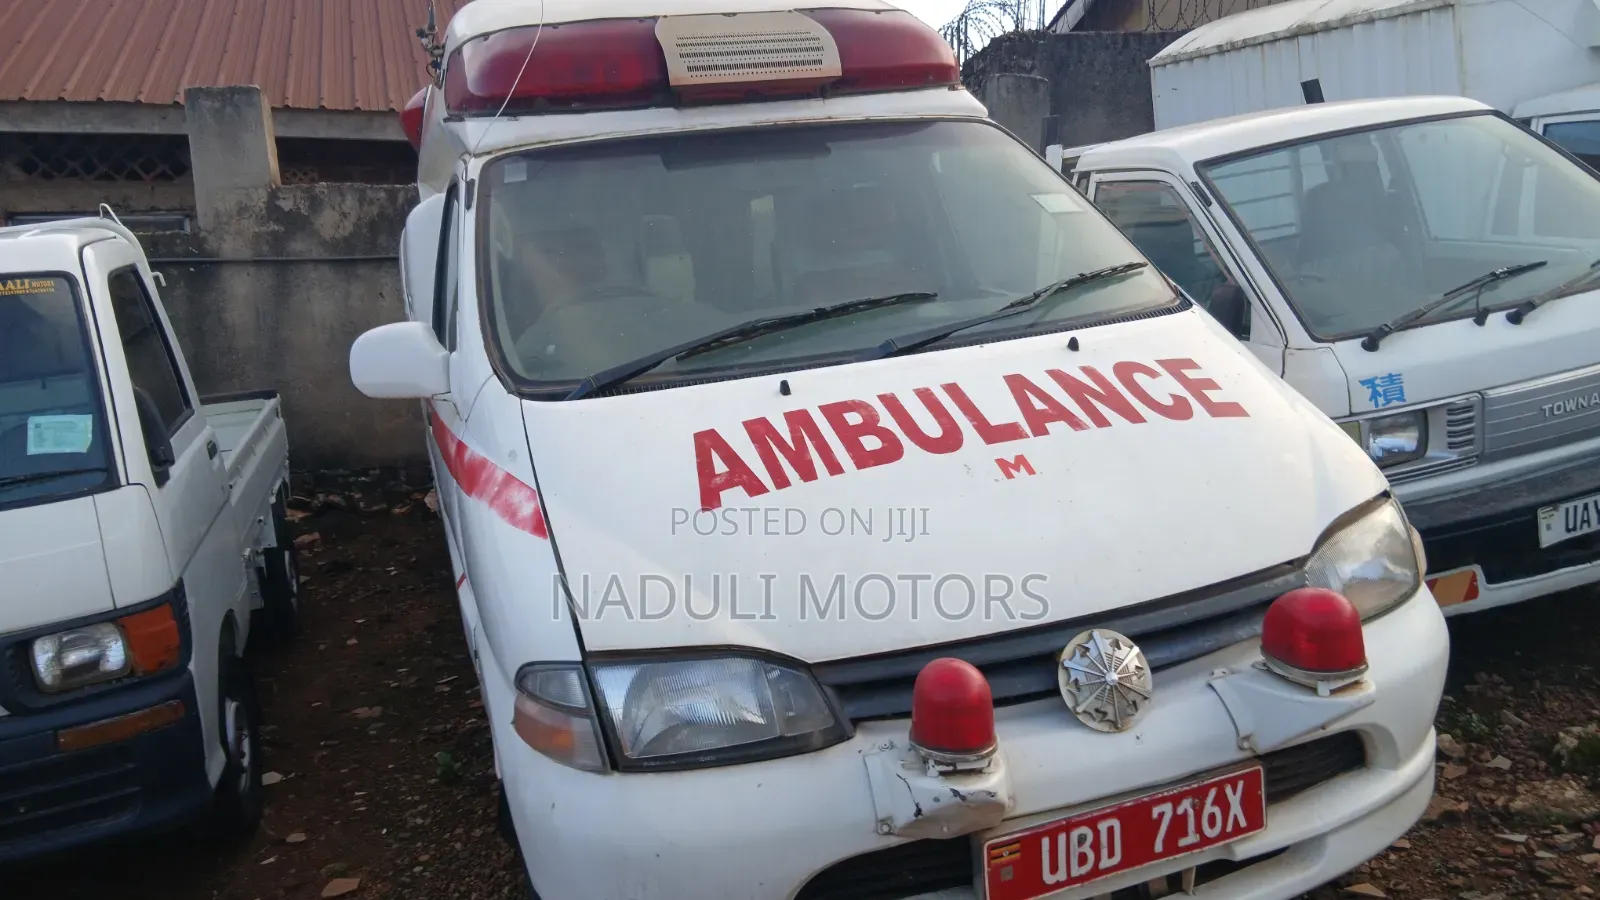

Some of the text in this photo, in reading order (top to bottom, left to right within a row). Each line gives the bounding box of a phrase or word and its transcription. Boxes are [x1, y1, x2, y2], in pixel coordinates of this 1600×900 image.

[1357, 372, 1407, 409] 積
[693, 358, 1247, 512] AMBULANCE
[994, 454, 1036, 480] M
[1041, 780, 1248, 885] UBD 716X
